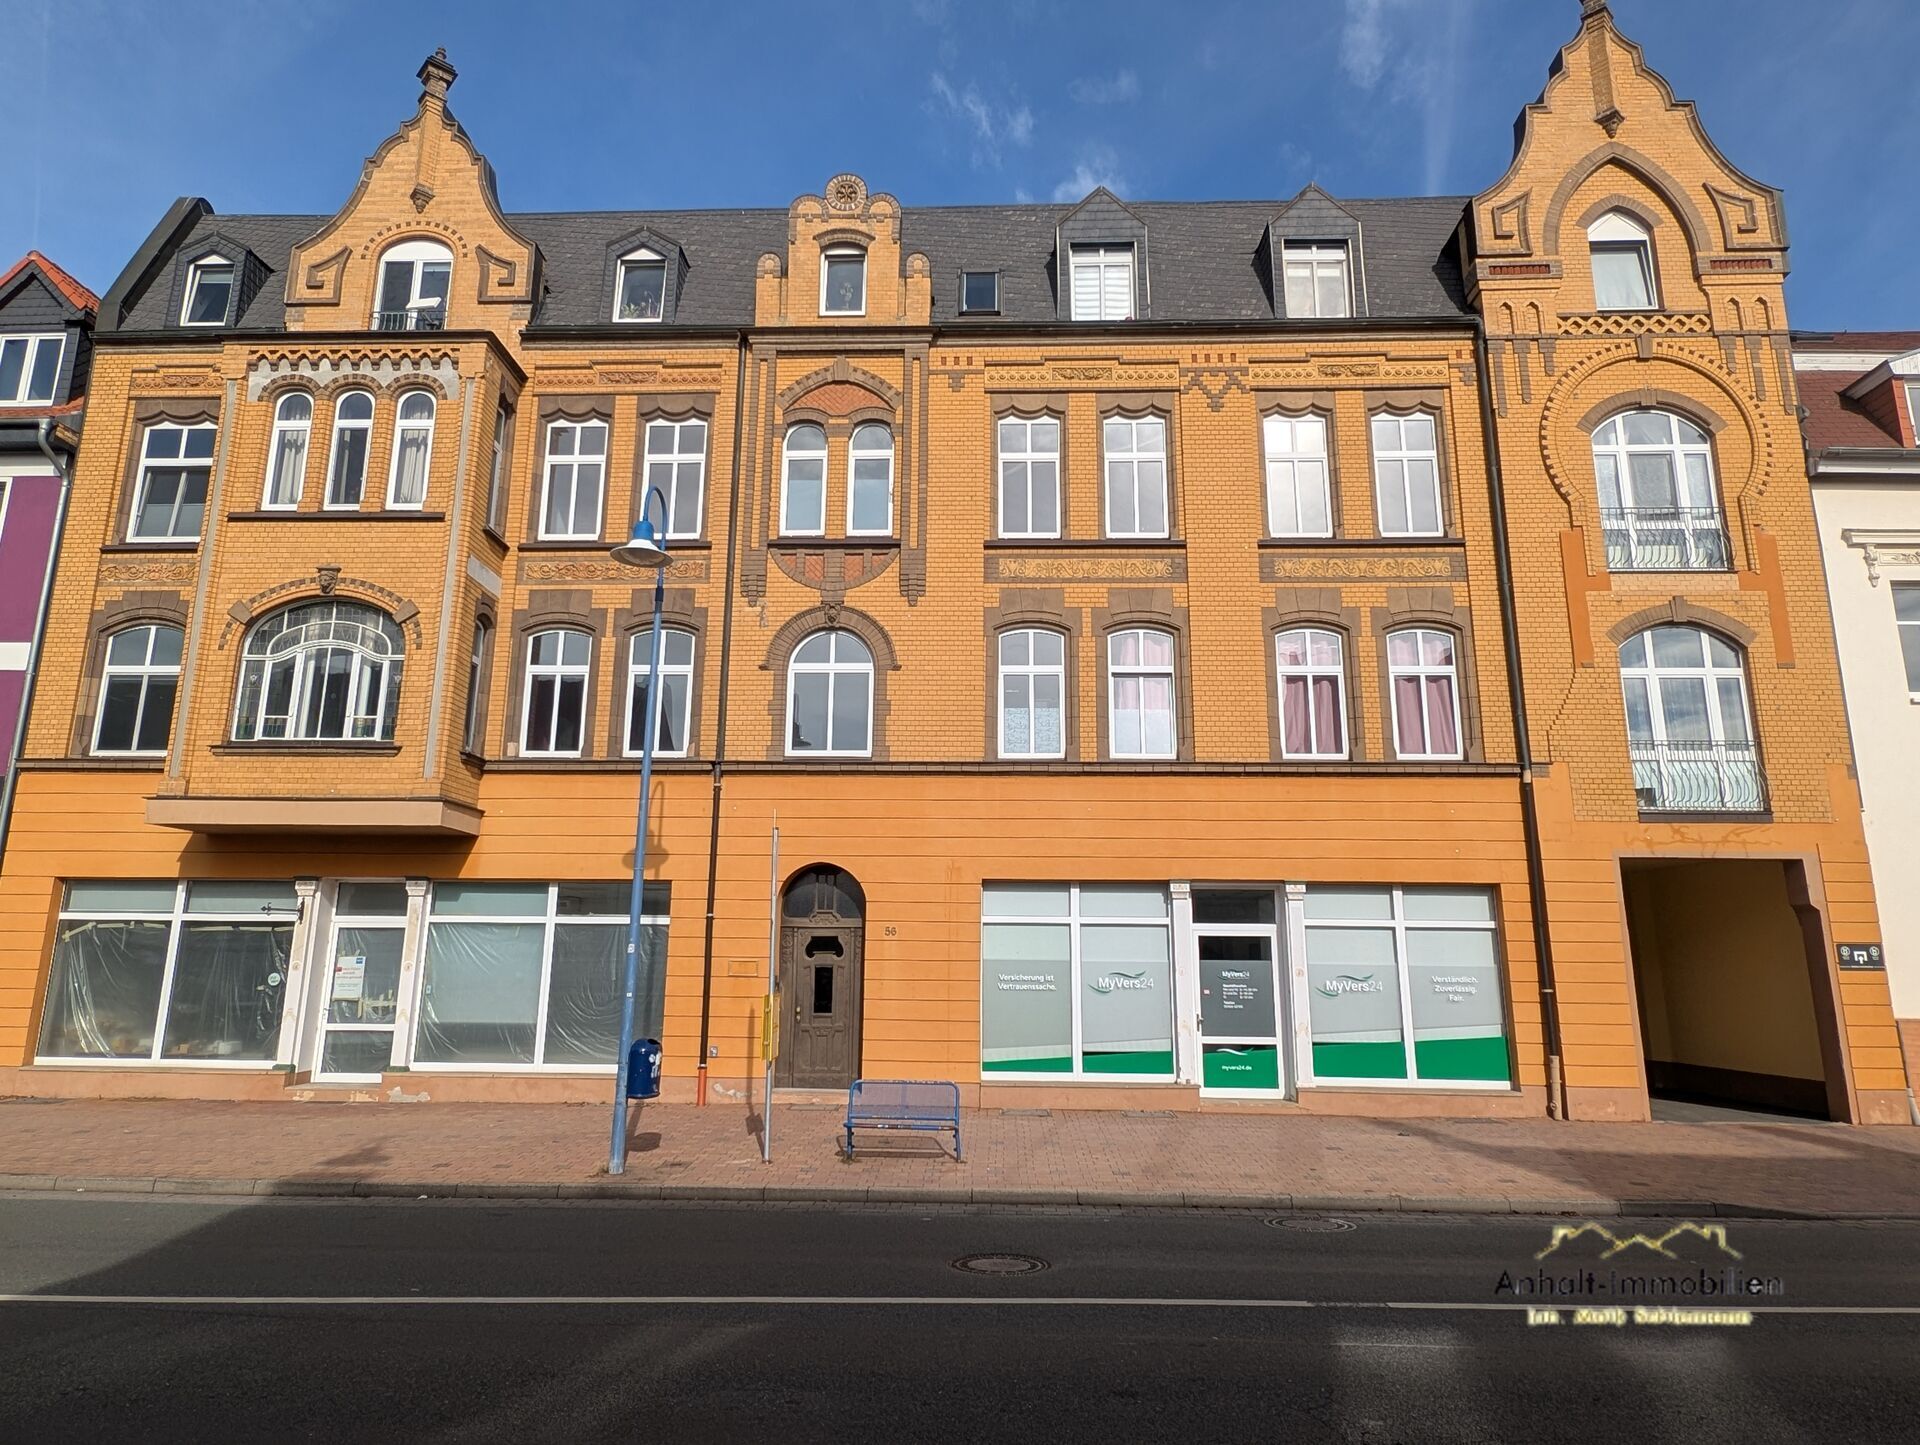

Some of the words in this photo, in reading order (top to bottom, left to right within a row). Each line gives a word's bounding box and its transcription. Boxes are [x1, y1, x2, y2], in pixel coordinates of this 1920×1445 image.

[884, 926, 897, 937] 56
[998, 973, 1045, 982] Versicherung
[1045, 973, 1055, 982] ist
[997, 982, 1057, 991] Vertrauenssache.
[1098, 977, 1154, 990] MyVers24
[1325, 980, 1383, 993] MyVers24
